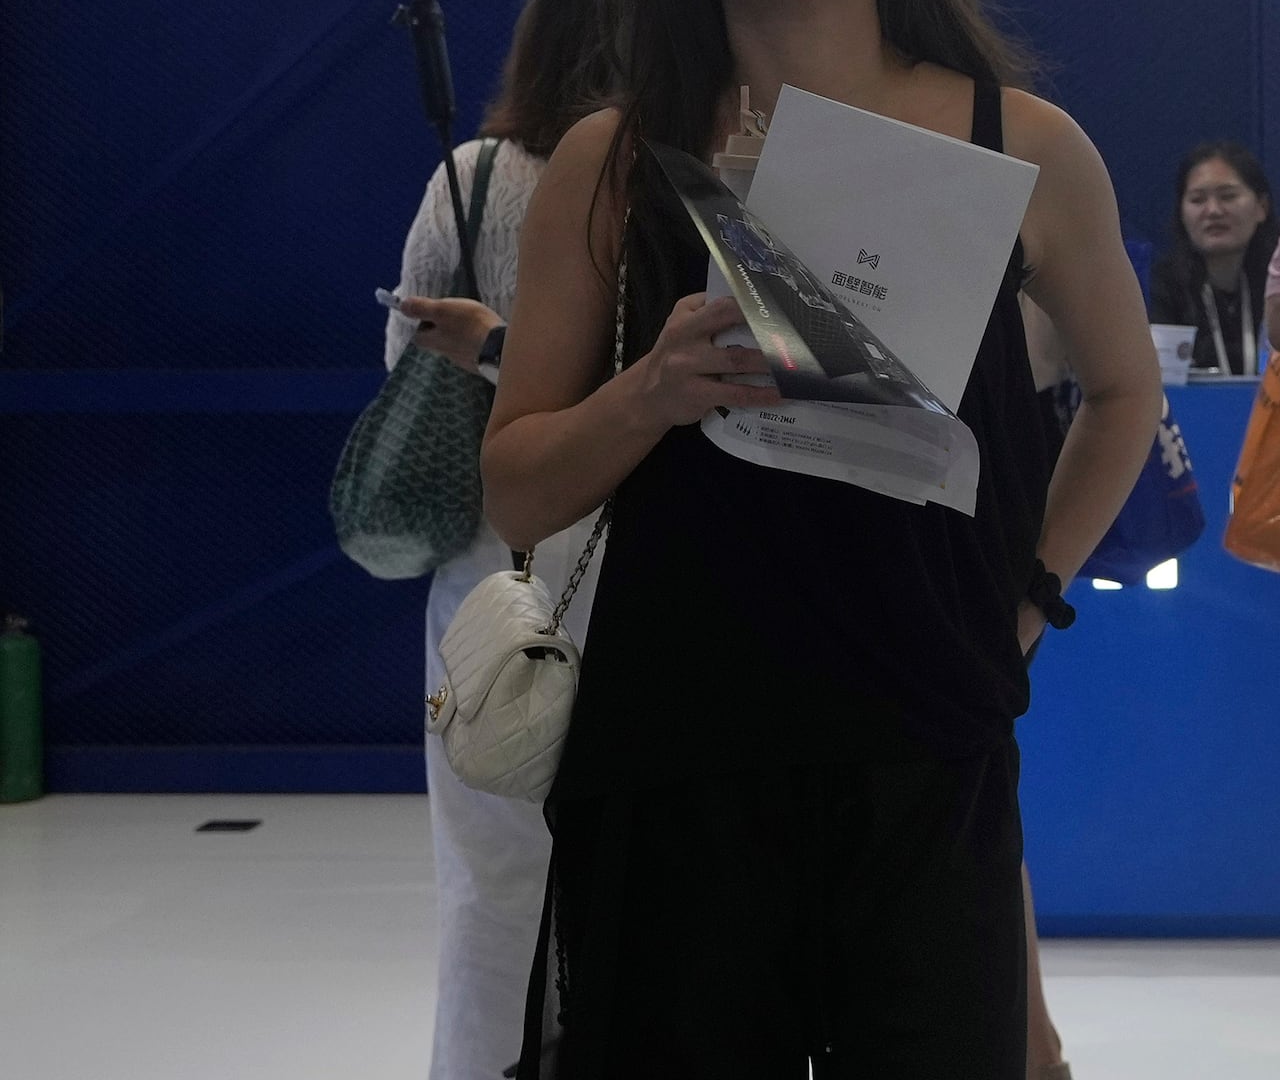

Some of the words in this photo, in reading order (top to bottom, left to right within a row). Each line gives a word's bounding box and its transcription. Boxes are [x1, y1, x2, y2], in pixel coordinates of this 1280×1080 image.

[736, 263, 770, 319] Qualcomm
[831, 270, 889, 301] 面壁智能
